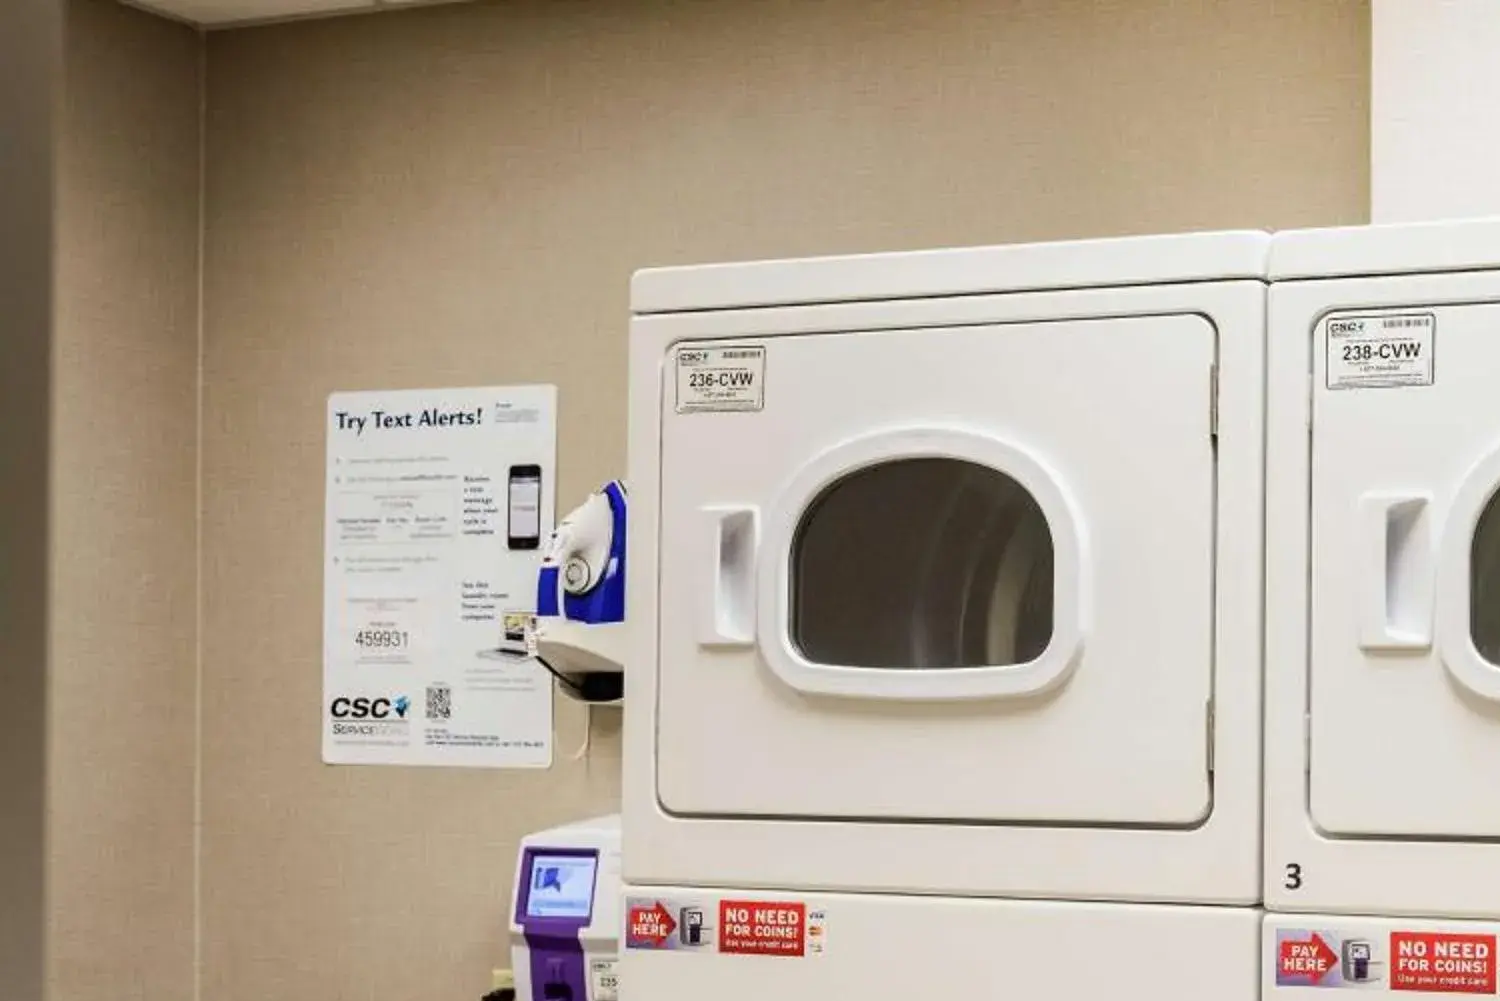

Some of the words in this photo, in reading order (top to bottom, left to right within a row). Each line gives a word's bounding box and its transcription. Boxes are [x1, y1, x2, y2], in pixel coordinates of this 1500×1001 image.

[1343, 342, 1421, 361] 238-CVW
[689, 371, 753, 387] 236-CVW
[336, 412, 366, 436] Try
[372, 410, 413, 429] Text
[418, 407, 483, 429] Alerts!
[331, 697, 391, 719] CSC
[1284, 863, 1302, 890] 3
[639, 911, 661, 923] PAY
[725, 907, 749, 923] NO
[754, 910, 799, 926] NEED
[633, 924, 667, 937] HERE
[725, 924, 750, 937] FOR
[755, 926, 798, 939] COINS!
[1291, 945, 1319, 958] PAY
[1399, 941, 1428, 958] NO
[1434, 942, 1489, 959] NEED
[1283, 958, 1327, 972] HERE
[1399, 958, 1430, 972] FOR
[1435, 959, 1488, 975] COINS!
